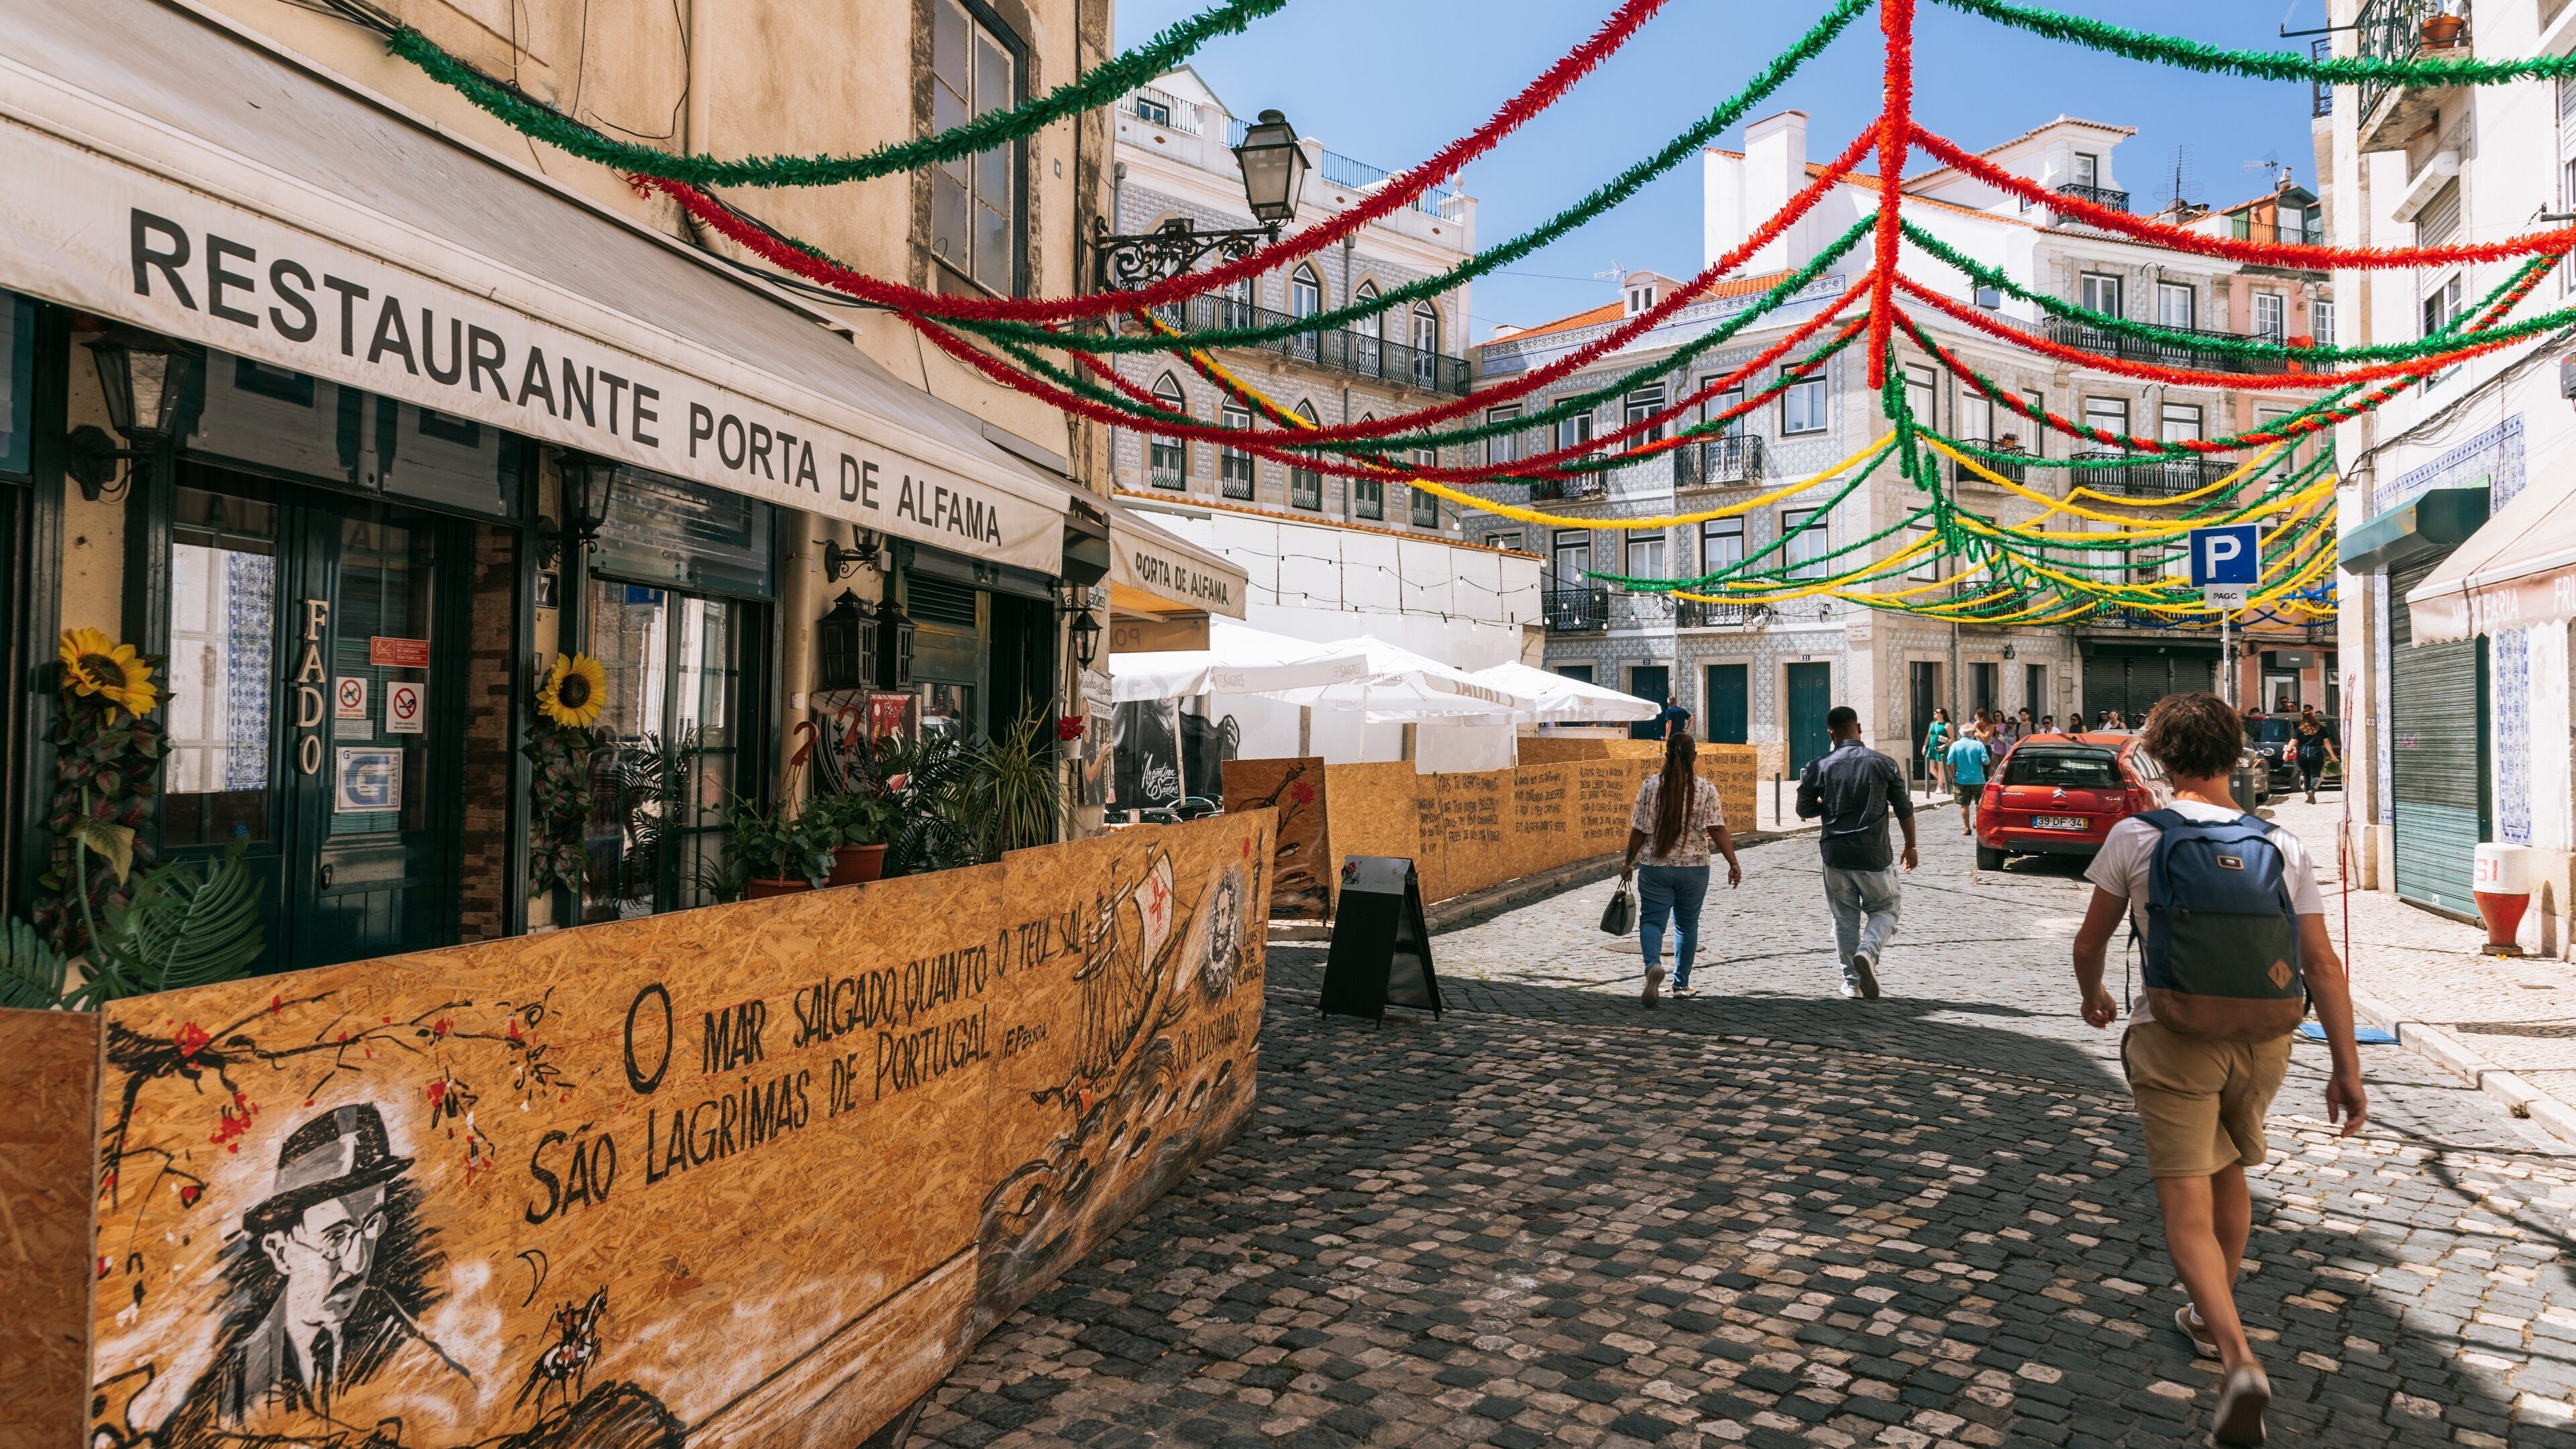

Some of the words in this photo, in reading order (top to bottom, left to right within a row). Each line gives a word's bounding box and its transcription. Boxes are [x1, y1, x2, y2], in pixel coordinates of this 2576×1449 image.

[131, 207, 659, 448] RESTAURANTE
[690, 401, 820, 493] PORTA
[841, 453, 879, 510] DE
[897, 475, 1002, 547] ALFAMA
[1135, 552, 1170, 588] PORTA
[1175, 566, 1187, 593] DE
[1191, 574, 1230, 606] ALFAMA
[2206, 535, 2241, 579] P
[2451, 588, 2519, 631] MERCEARIA
[296, 599, 330, 775] FADO
[1222, 674, 1244, 688] SAGRES
[624, 983, 672, 1094] O
[702, 1000, 766, 1074] MAR
[904, 943, 987, 1026] QUANTO
[997, 928, 1008, 977] O
[1059, 901, 1083, 959] SAL
[1177, 1030, 1192, 1072] OS
[525, 1120, 616, 1225] SÃO
[829, 1053, 858, 1119] DE
[874, 1004, 991, 1100] PORTUGAL
